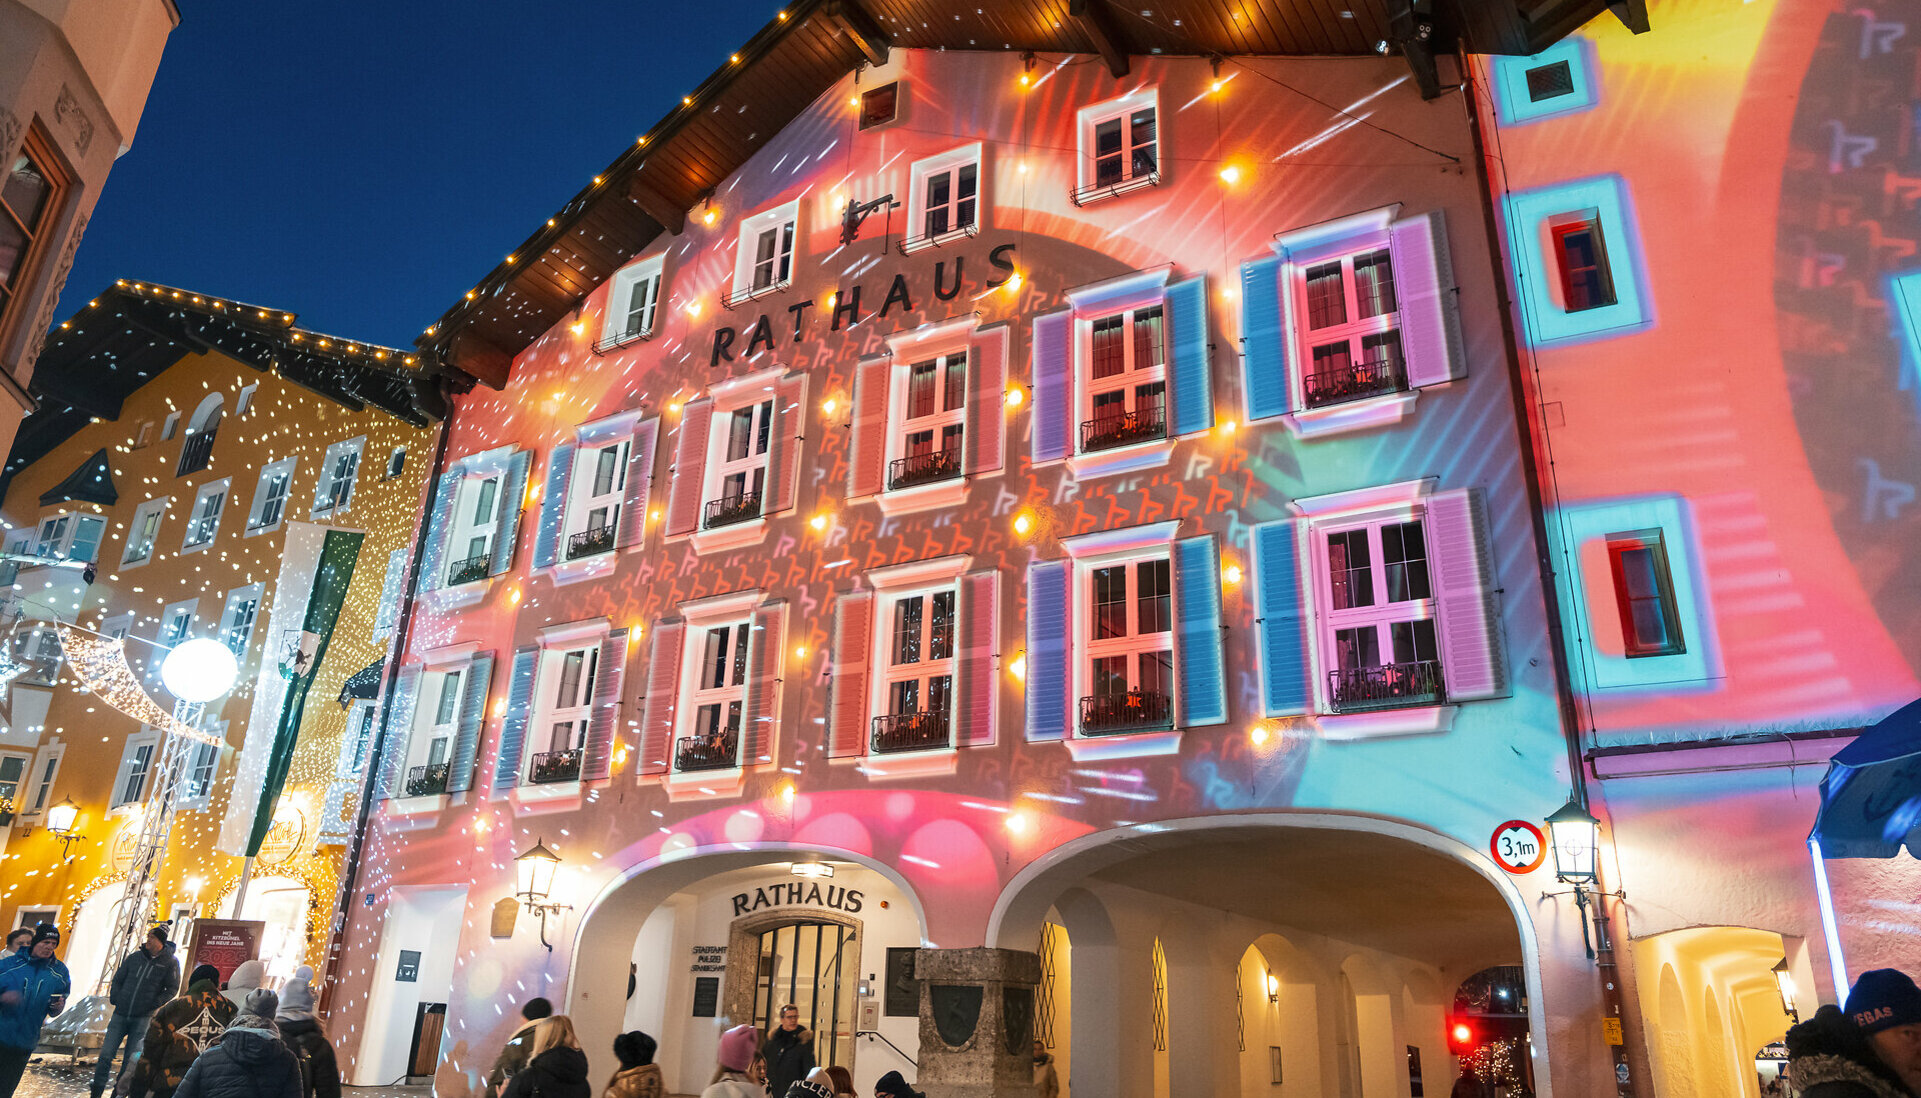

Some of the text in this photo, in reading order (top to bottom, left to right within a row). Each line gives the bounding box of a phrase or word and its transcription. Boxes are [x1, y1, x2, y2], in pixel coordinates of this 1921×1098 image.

[711, 244, 1016, 367] RATHAUS
[1502, 836, 1535, 858] 3,1m
[732, 882, 864, 916] RATHAUS
[692, 946, 728, 954] STADTAMT
